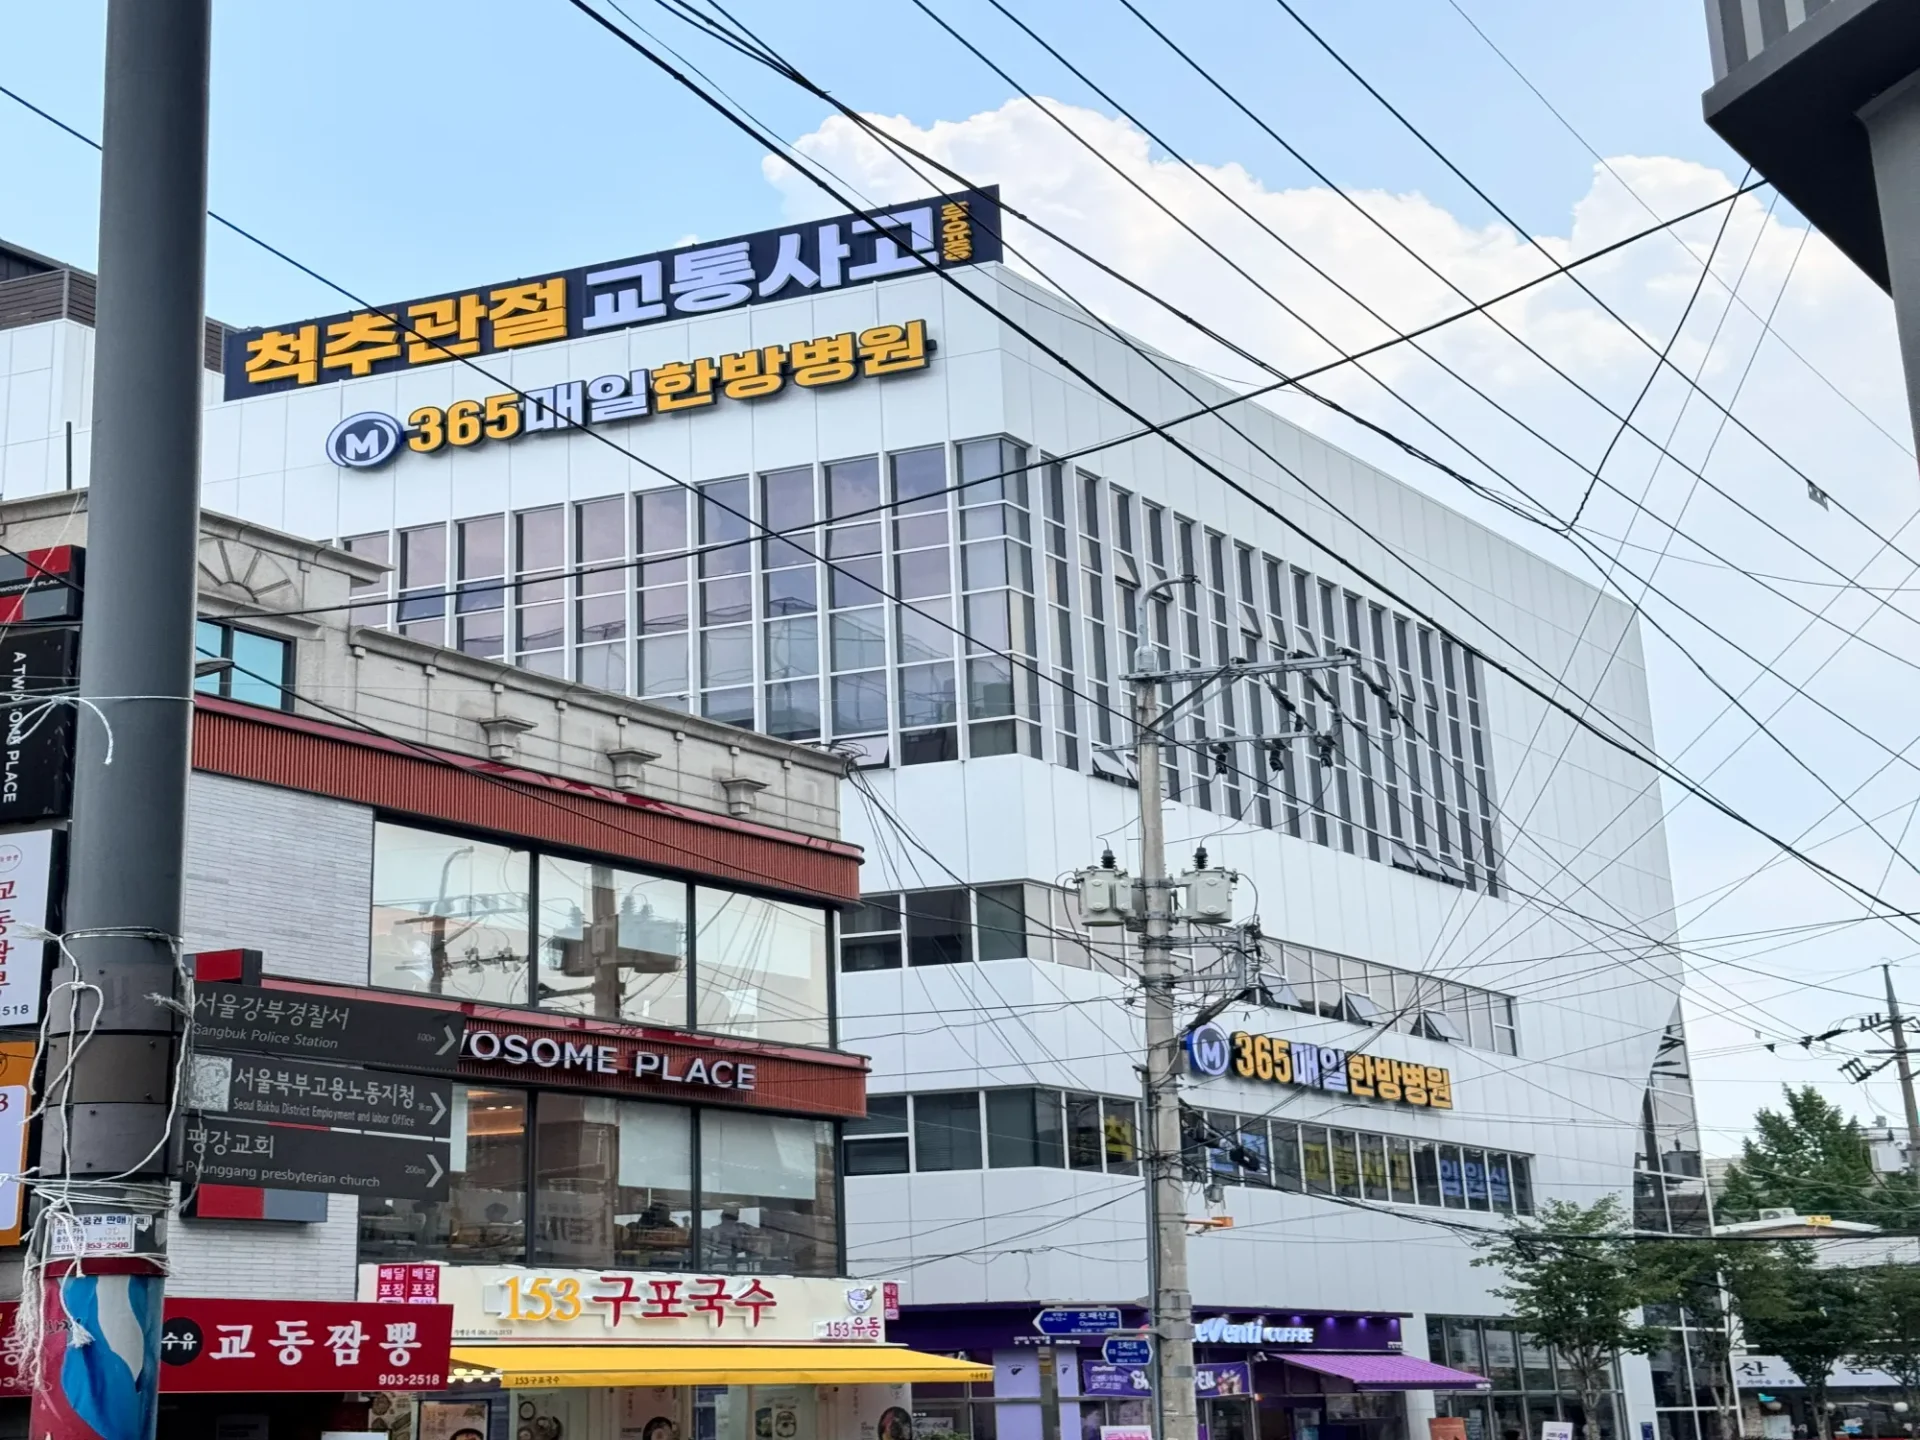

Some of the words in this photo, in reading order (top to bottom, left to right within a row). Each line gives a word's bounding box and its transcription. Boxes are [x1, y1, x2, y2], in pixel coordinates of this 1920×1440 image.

[246, 277, 568, 385] 척추관절
[582, 205, 939, 330] 교통사고
[407, 319, 927, 454] 365매일한방병원
[3, 750, 20, 803] PLACE
[195, 991, 350, 1031] 서울강북경찰서
[192, 1022, 248, 1041] Gangbuk
[251, 1029, 290, 1044] Police
[293, 1033, 339, 1050] Station
[461, 1029, 618, 1075] OSOME
[635, 1051, 756, 1091] PLACE
[1232, 1031, 1453, 1110] 365매일한방병원
[234, 1066, 415, 1109] 서울북부고용노동지청
[233, 1097, 255, 1111] Seoul
[256, 1099, 281, 1114] Bukbu
[281, 1102, 311, 1118] District
[312, 1106, 356, 1123] Employment
[357, 1110, 371, 1123] and
[391, 1113, 416, 1128] Office
[185, 1160, 257, 1180] Pyunggang
[262, 1168, 337, 1186] presbyterian
[339, 1174, 381, 1188] church
[380, 1267, 406, 1281] 배달
[411, 1267, 436, 1281] 배달
[379, 1283, 405, 1297] 포장
[411, 1283, 436, 1297] 포장
[1077, 1311, 1118, 1320] 오패산로
[1192, 1317, 1262, 1344] eVenti
[1264, 1326, 1314, 1344] COFFEE
[161, 1332, 198, 1351] 수유
[209, 1319, 423, 1368] 교동짬뽕
[378, 1374, 441, 1386] 903-2518
